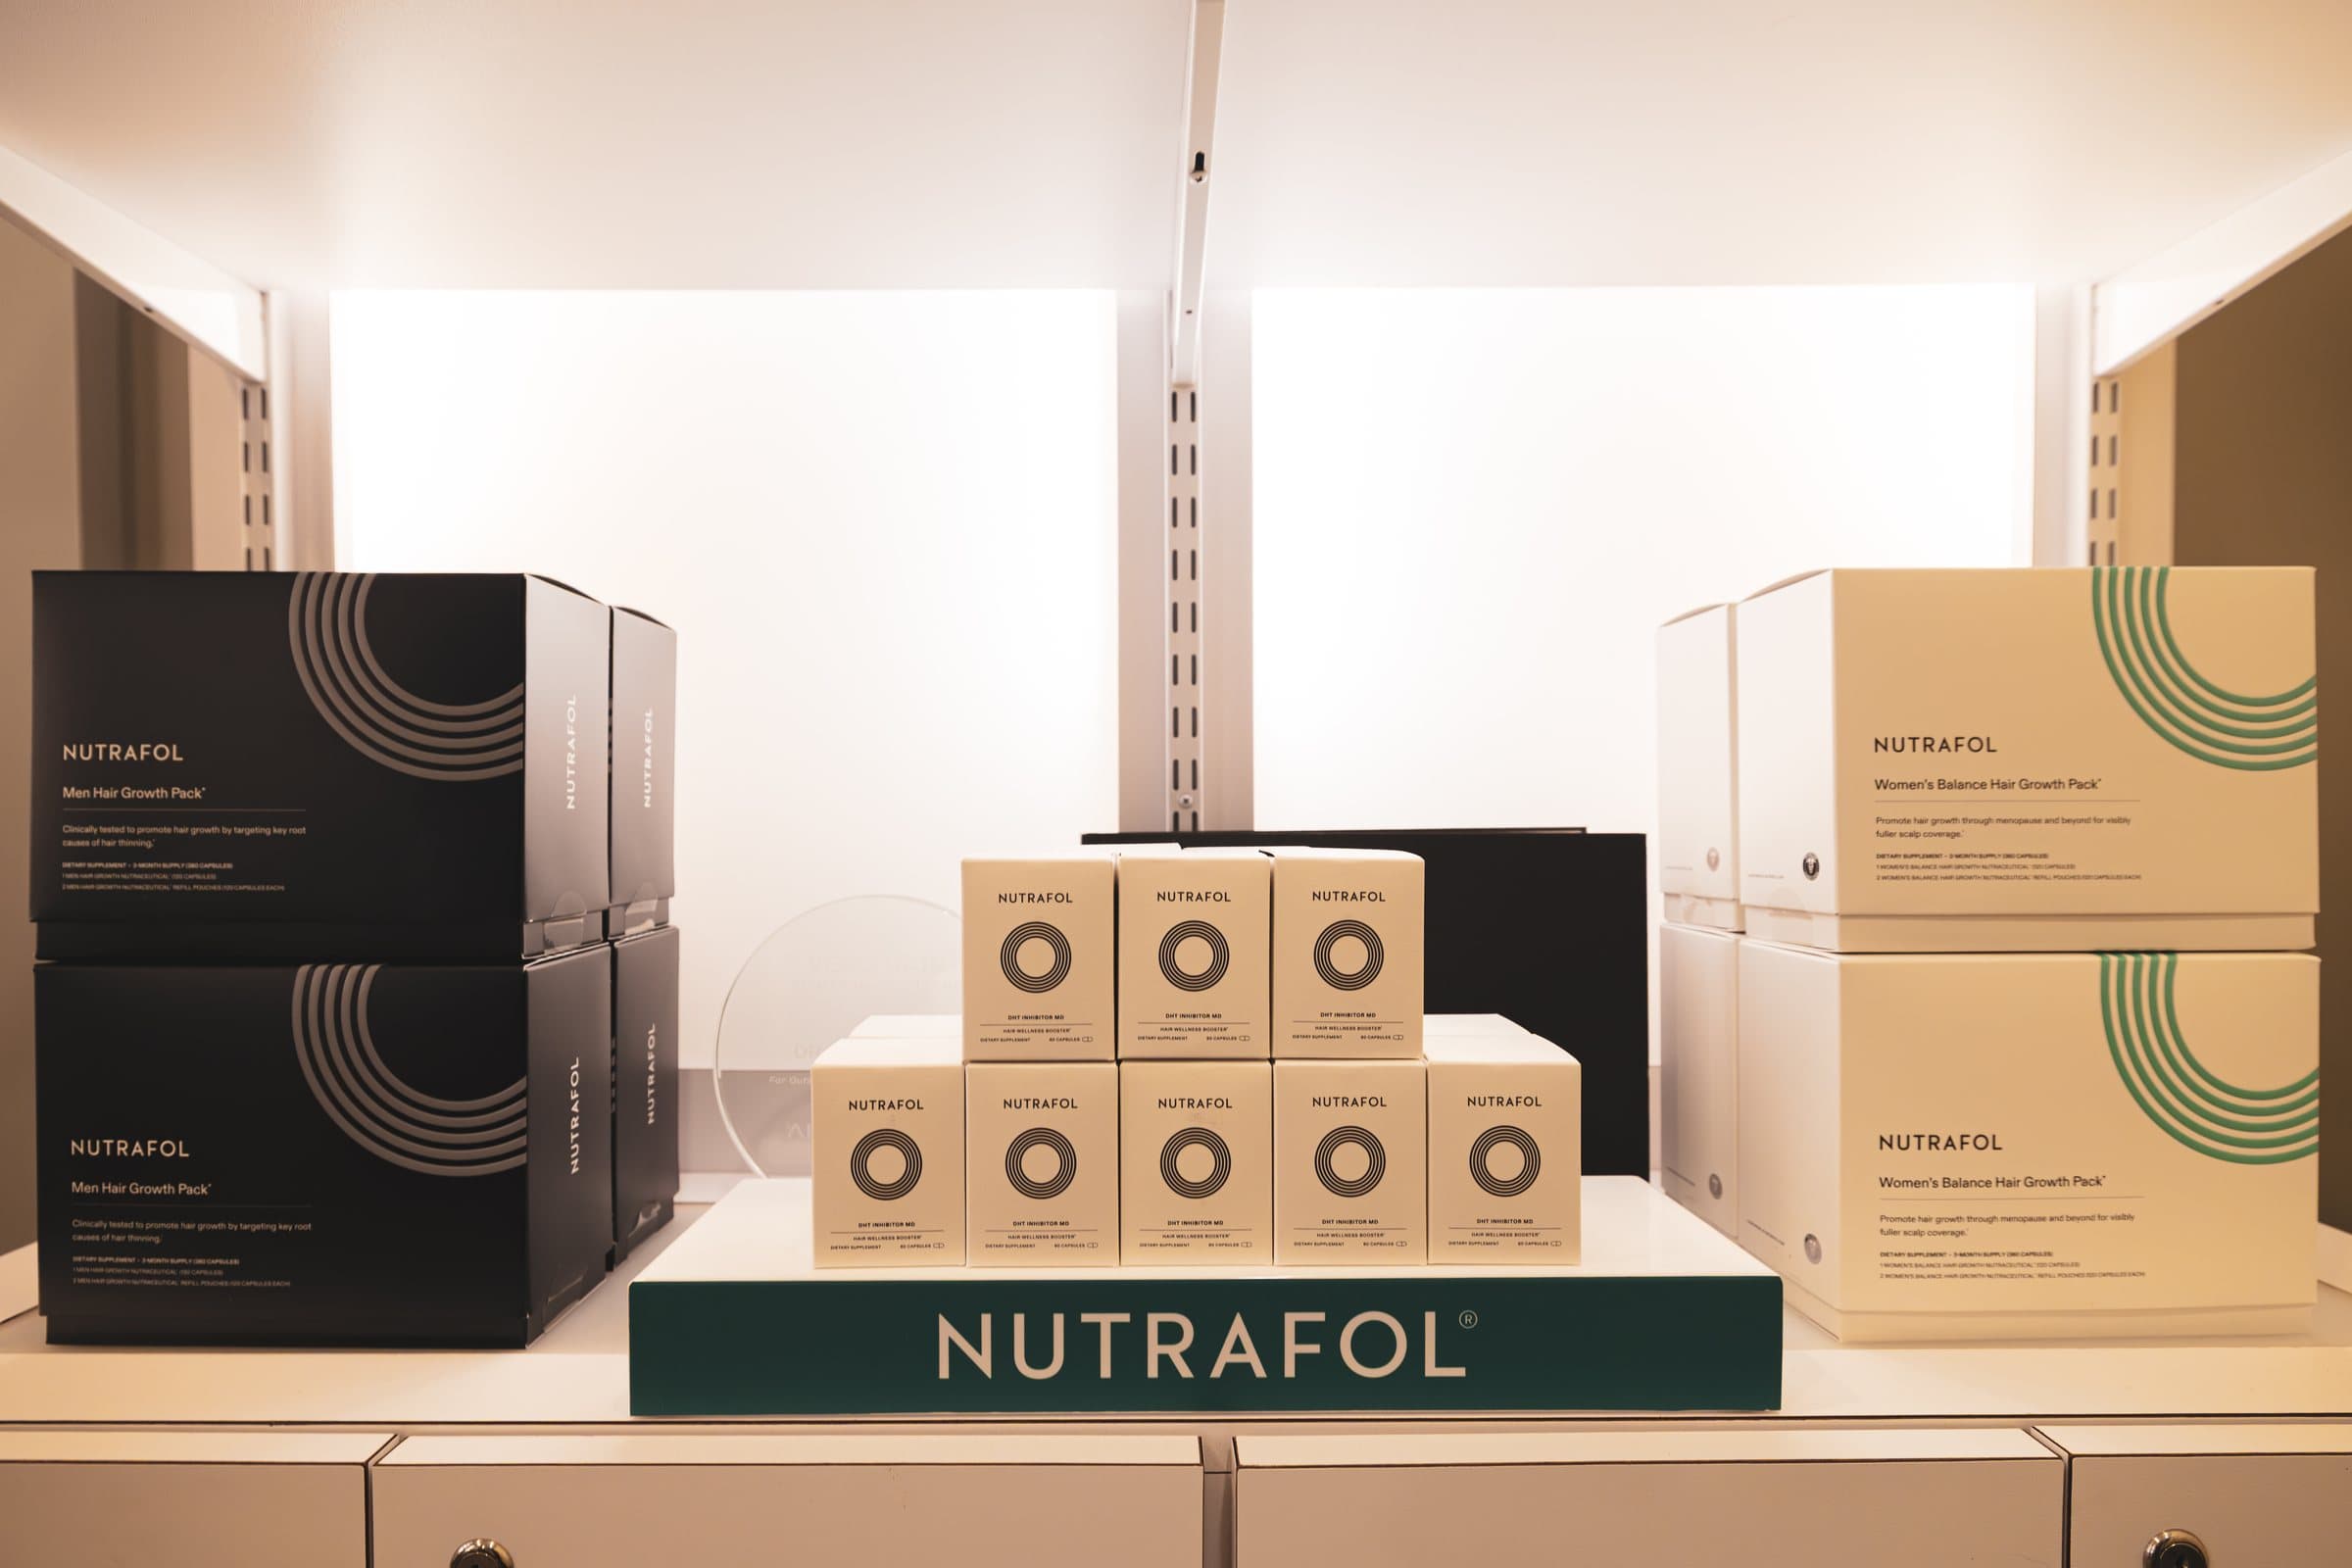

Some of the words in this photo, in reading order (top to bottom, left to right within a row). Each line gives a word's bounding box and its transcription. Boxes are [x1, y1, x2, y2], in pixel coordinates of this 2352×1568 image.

[1875, 737, 1997, 753] NUTRAFOL
[64, 744, 183, 760] NUTRAFOL
[566, 694, 576, 809] NUTRAFOL
[644, 708, 654, 808] NUTRAFOL
[1875, 779, 1935, 790] Women's
[1937, 779, 1987, 790] Balance
[1990, 779, 2016, 790] Hair
[2019, 778, 2065, 790] Growth
[63, 787, 90, 799] Men
[93, 787, 119, 799] Hair
[121, 787, 168, 799] Growth
[1876, 815, 1912, 825] Promote
[1913, 816, 1929, 825] hair
[1931, 816, 1960, 827] growth
[1961, 816, 1994, 827] through
[1995, 817, 2042, 826] menopause
[2044, 815, 2059, 825] and
[2061, 816, 2091, 826] beyond
[2092, 815, 2104, 824] for
[2106, 815, 2131, 826] visibly
[63, 824, 98, 835] Clinically
[99, 825, 125, 834] tested
[126, 825, 135, 834] to
[137, 825, 172, 836] promote
[173, 825, 189, 835] hair
[190, 825, 220, 837] growth
[221, 825, 232, 836] by
[234, 826, 271, 837] targeting
[272, 825, 287, 836] key
[289, 826, 306, 835] root
[1876, 829, 1897, 839] fuller
[1899, 830, 1921, 840] scalp
[63, 839, 90, 848] causes
[91, 838, 100, 848] of
[101, 838, 117, 848] hair
[999, 893, 1073, 904] NUTRAFOL
[1157, 891, 1231, 903] NUTRAFOL
[1313, 891, 1386, 902] NUTRAFOL
[849, 1100, 923, 1110] NUTRAFOL
[1004, 1098, 1078, 1109] NUTRAFOL
[1158, 1098, 1232, 1108] NUTRAFOL
[1313, 1097, 1387, 1107] NUTRAFOL
[1468, 1096, 1542, 1107] NUTRAFOL
[570, 1056, 579, 1175] NUTRAFOL
[72, 1140, 189, 1156] NUTRAFOL
[1880, 1134, 2002, 1151] NUTRAFOL
[1879, 1177, 1938, 1188] Women's
[1942, 1177, 1992, 1188] Balance
[1995, 1177, 2021, 1188] Hair
[2024, 1176, 2070, 1188] Growth
[72, 1182, 98, 1194] Men
[102, 1182, 126, 1194] Hair
[129, 1182, 175, 1195] Growth
[1880, 1214, 1916, 1224] Promote
[1918, 1214, 1933, 1224] hair
[1936, 1215, 1965, 1225] growth
[1966, 1214, 1998, 1225] through
[1999, 1215, 2047, 1224] menopause
[2049, 1214, 2064, 1223] and
[2066, 1214, 2096, 1224] beyond
[2097, 1212, 2108, 1222] for
[2110, 1212, 2134, 1222] visibly
[73, 1218, 107, 1230] Clinically
[109, 1220, 134, 1229] tested
[145, 1222, 178, 1231] promote
[198, 1222, 226, 1232] growth
[228, 1222, 238, 1232] by
[240, 1222, 276, 1233] targeting
[278, 1222, 292, 1232] key
[294, 1222, 311, 1232] root
[102, 1233, 110, 1243] of
[112, 1233, 125, 1243] hair
[1880, 1227, 1900, 1237] fuller
[1903, 1228, 1926, 1239] scalp
